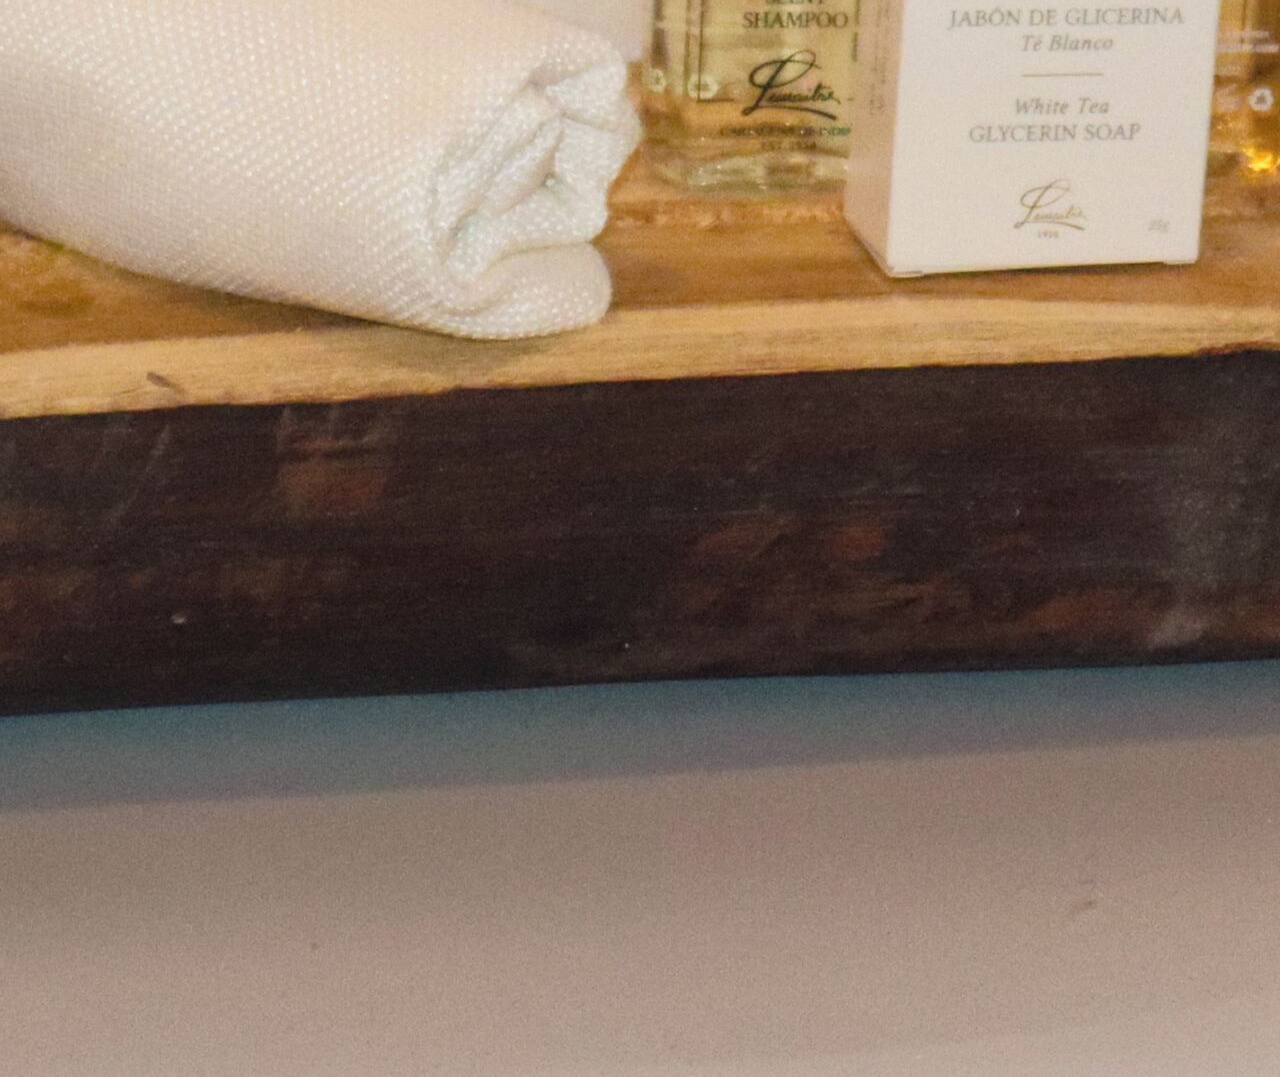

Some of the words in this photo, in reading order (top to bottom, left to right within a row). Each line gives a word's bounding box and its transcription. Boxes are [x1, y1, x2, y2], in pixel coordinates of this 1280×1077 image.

[741, 10, 850, 30] SHAMPOO
[948, 6, 1022, 31] JABÓN
[1028, 9, 1058, 26] DE
[1064, 6, 1186, 26] GLICERINA
[1020, 33, 1042, 52] Té
[1049, 33, 1115, 52] Blanco
[1014, 96, 1070, 115] White
[1077, 96, 1110, 115] Tea
[968, 124, 1077, 144] GLYCERIN
[1083, 122, 1141, 142] SOAP
